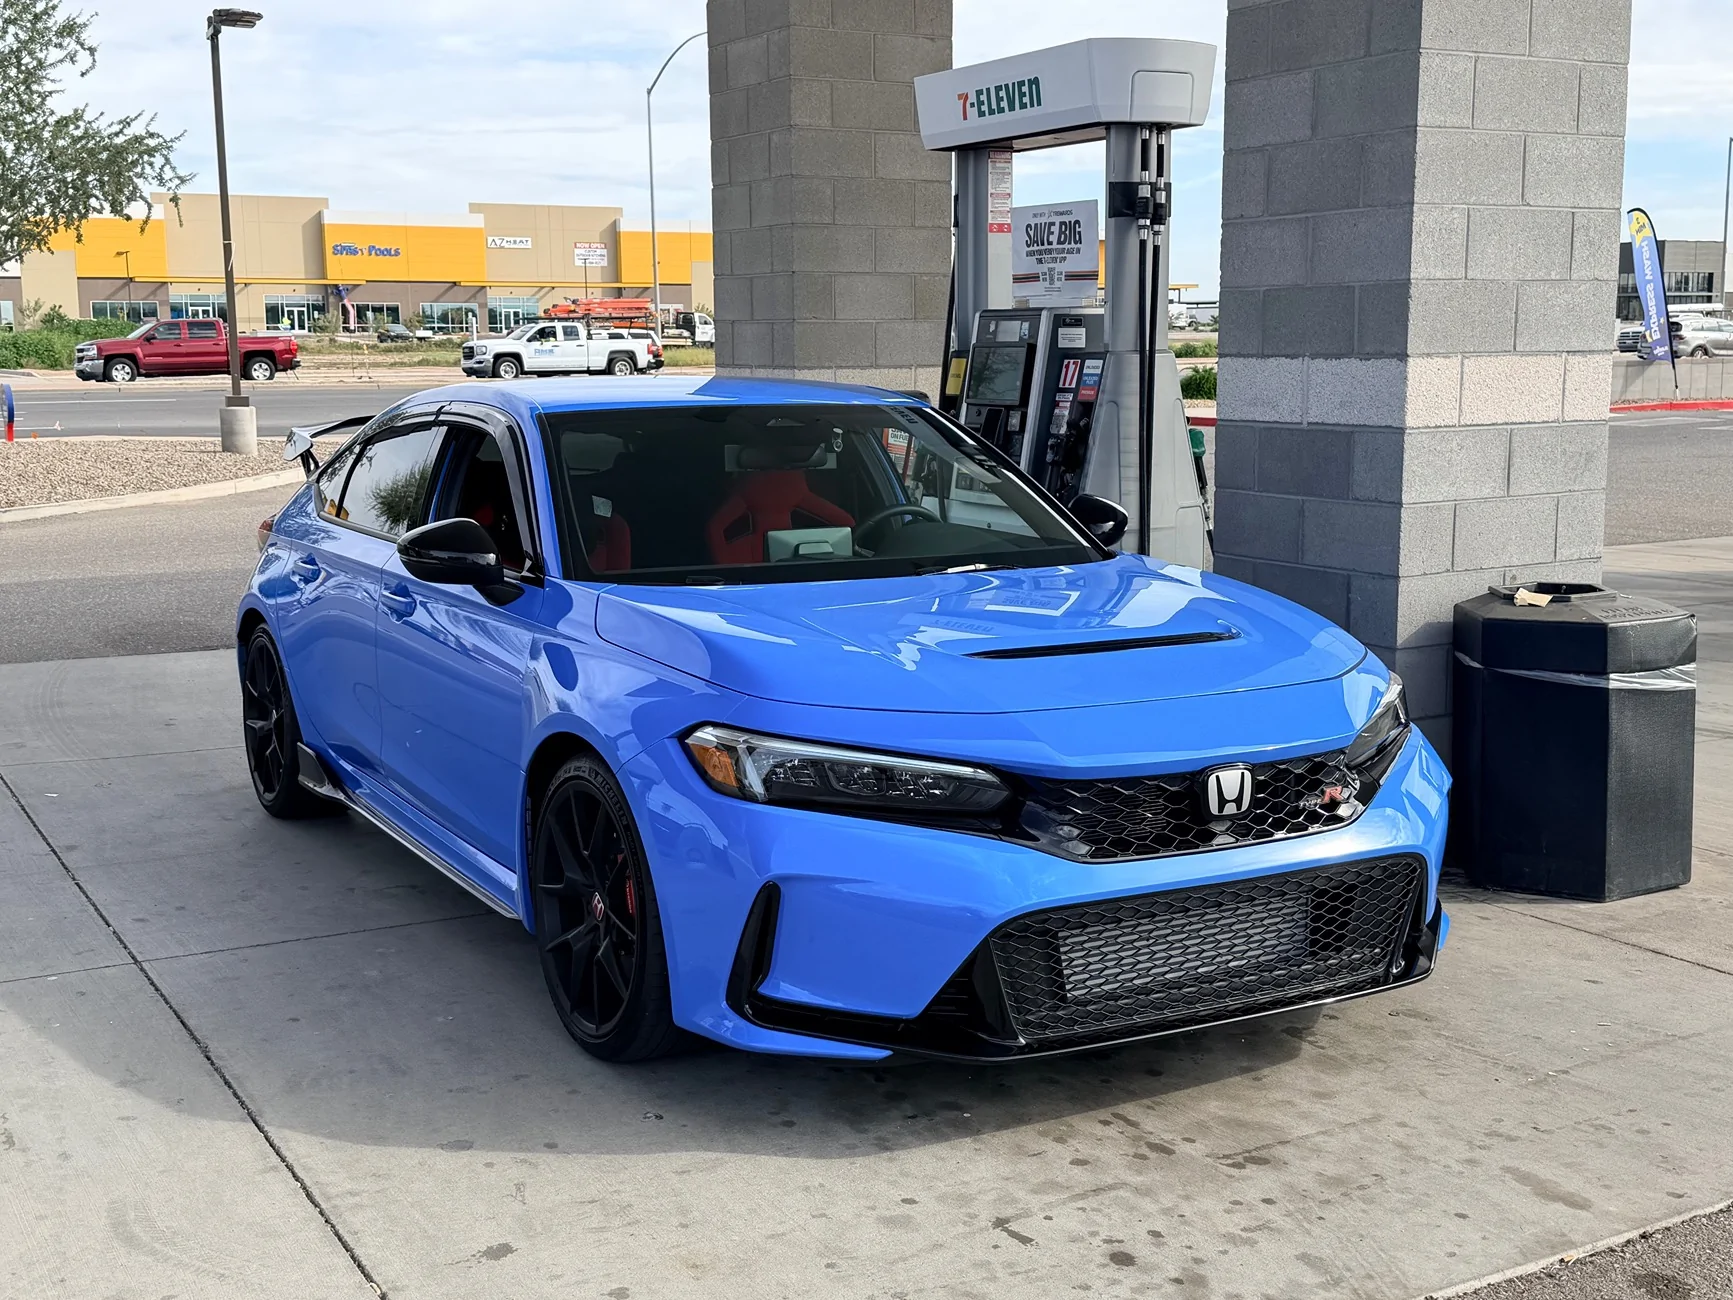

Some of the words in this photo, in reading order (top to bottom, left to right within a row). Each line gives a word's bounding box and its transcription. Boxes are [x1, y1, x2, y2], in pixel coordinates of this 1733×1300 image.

[489, 238, 505, 248] AZ
[1025, 221, 1056, 248] SAVE
[1056, 219, 1082, 246] BIG
[1062, 360, 1080, 387] 17
[899, 433, 909, 441] FUE
[594, 774, 628, 825] MICHELIN
[1322, 785, 1344, 804] R
